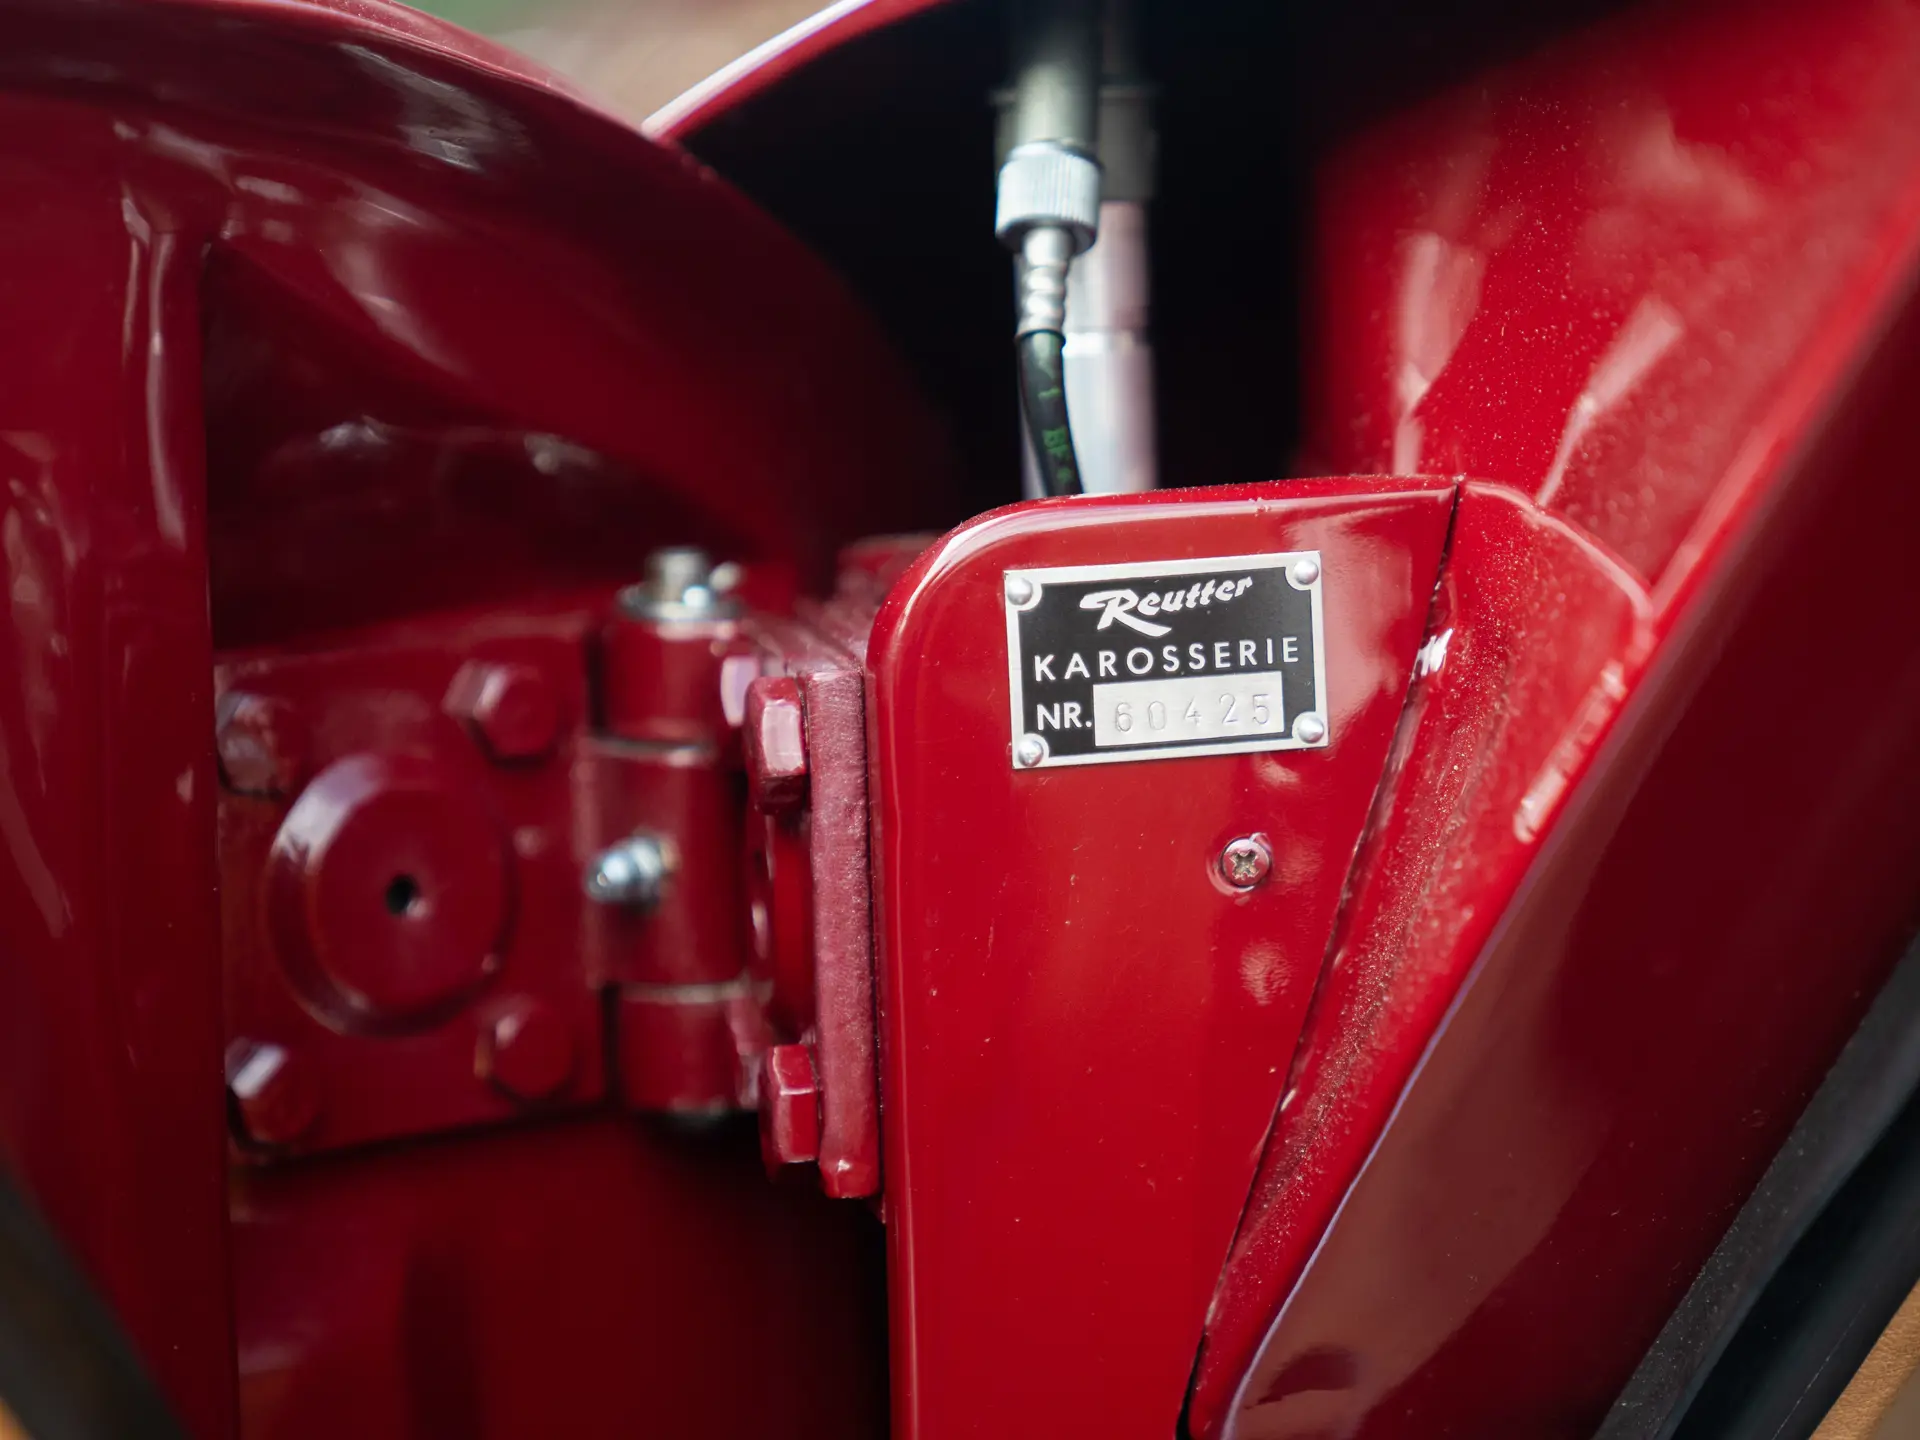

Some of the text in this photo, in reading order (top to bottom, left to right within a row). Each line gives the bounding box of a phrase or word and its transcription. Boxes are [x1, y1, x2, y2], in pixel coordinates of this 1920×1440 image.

[1080, 577, 1253, 637] Reutter
[1034, 637, 1299, 681] KAROSSERIE
[1037, 693, 1270, 732] NR. 60425
